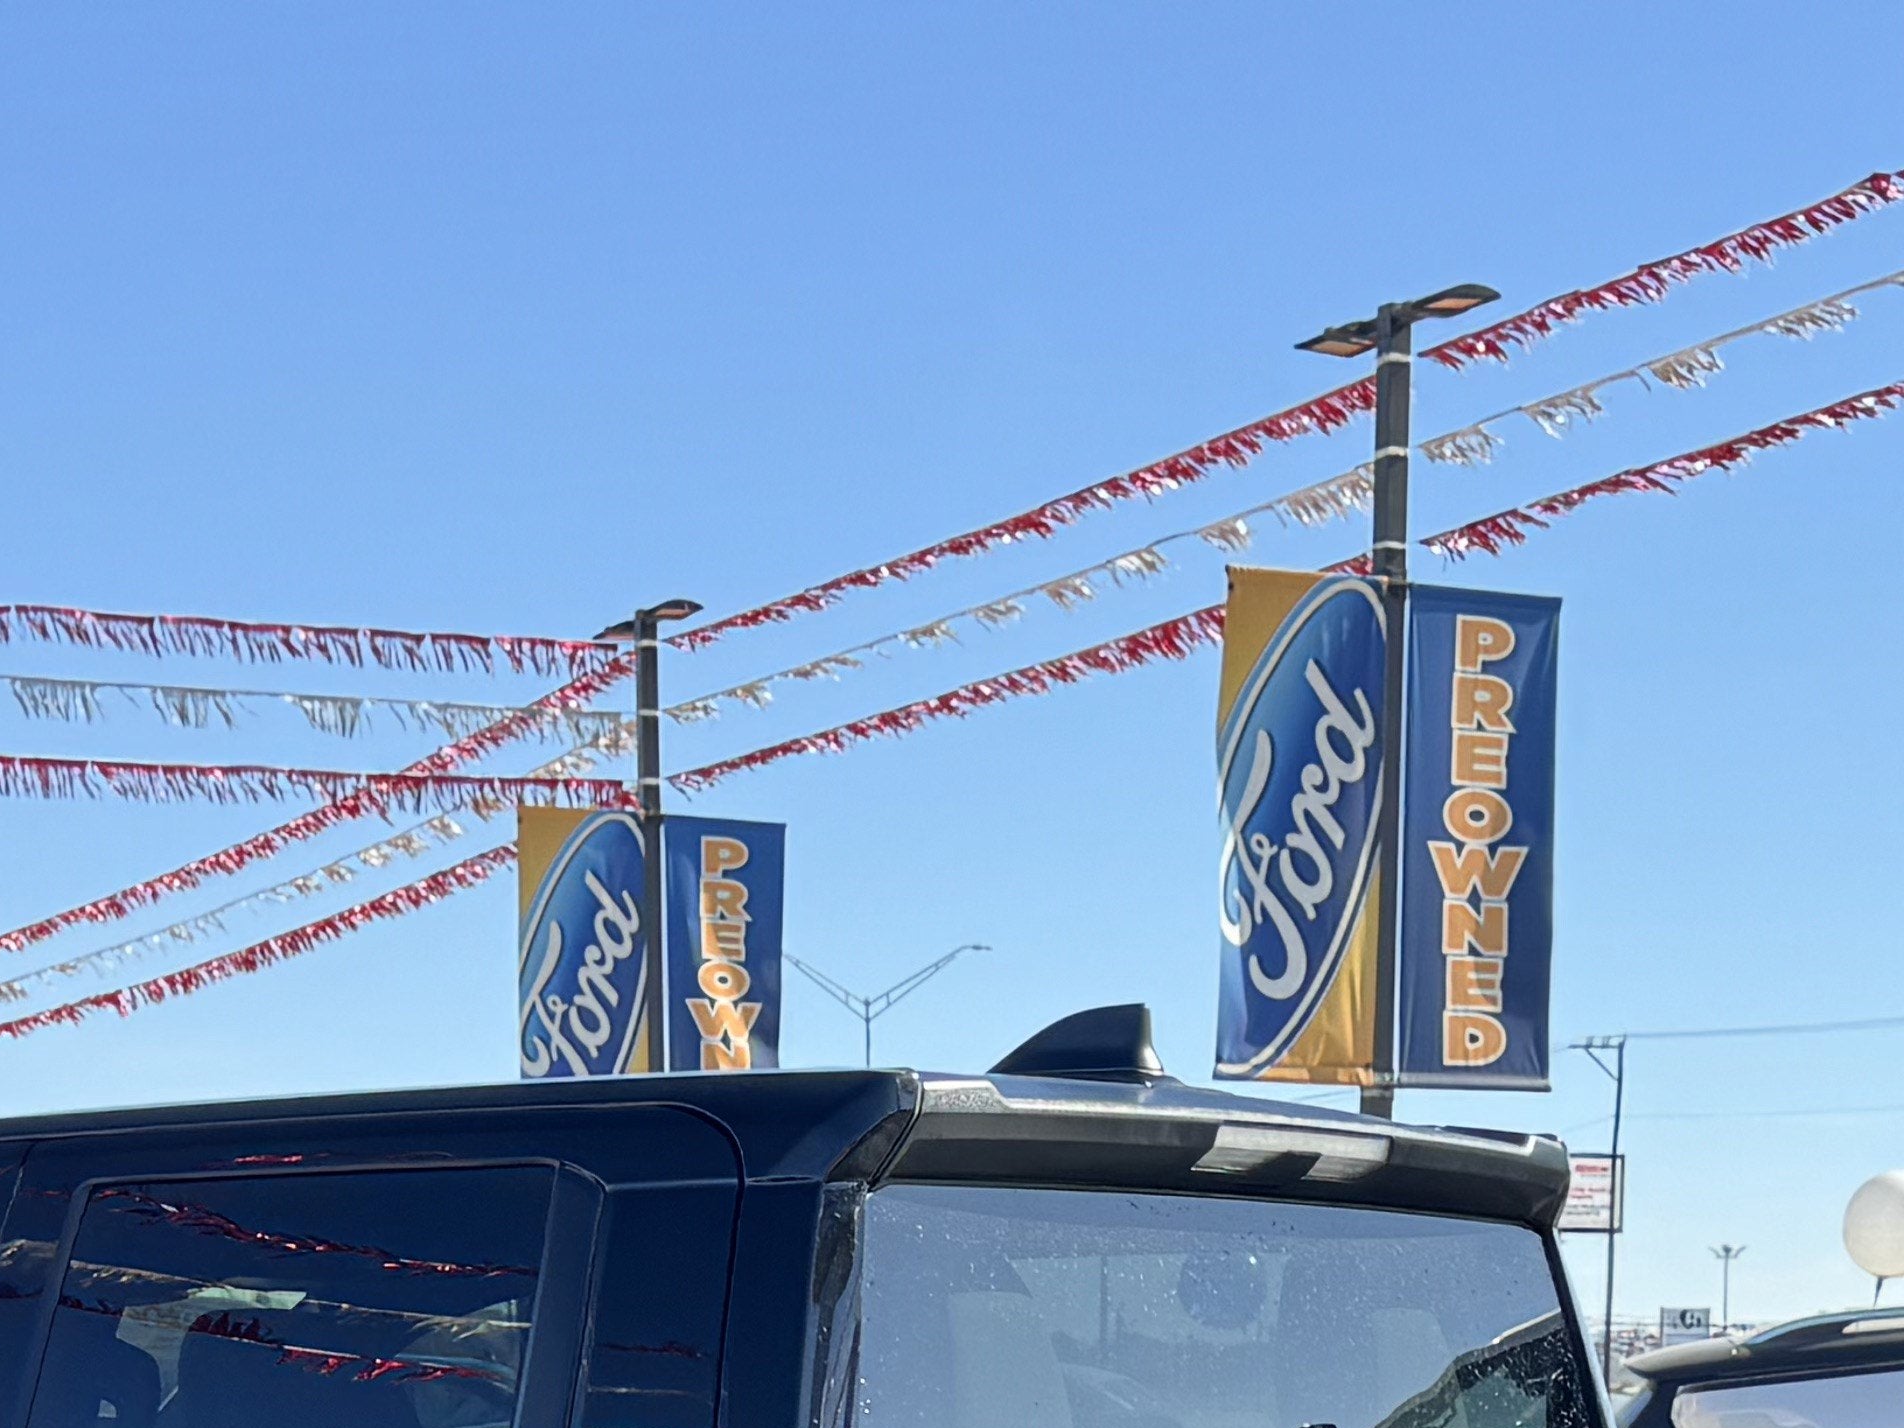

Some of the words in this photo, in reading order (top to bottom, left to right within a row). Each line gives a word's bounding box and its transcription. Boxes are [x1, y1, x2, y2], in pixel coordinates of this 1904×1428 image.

[521, 868, 640, 1078] Ford
[1220, 658, 1376, 1000] Ford
[1427, 614, 1529, 1067] PREOWNED
